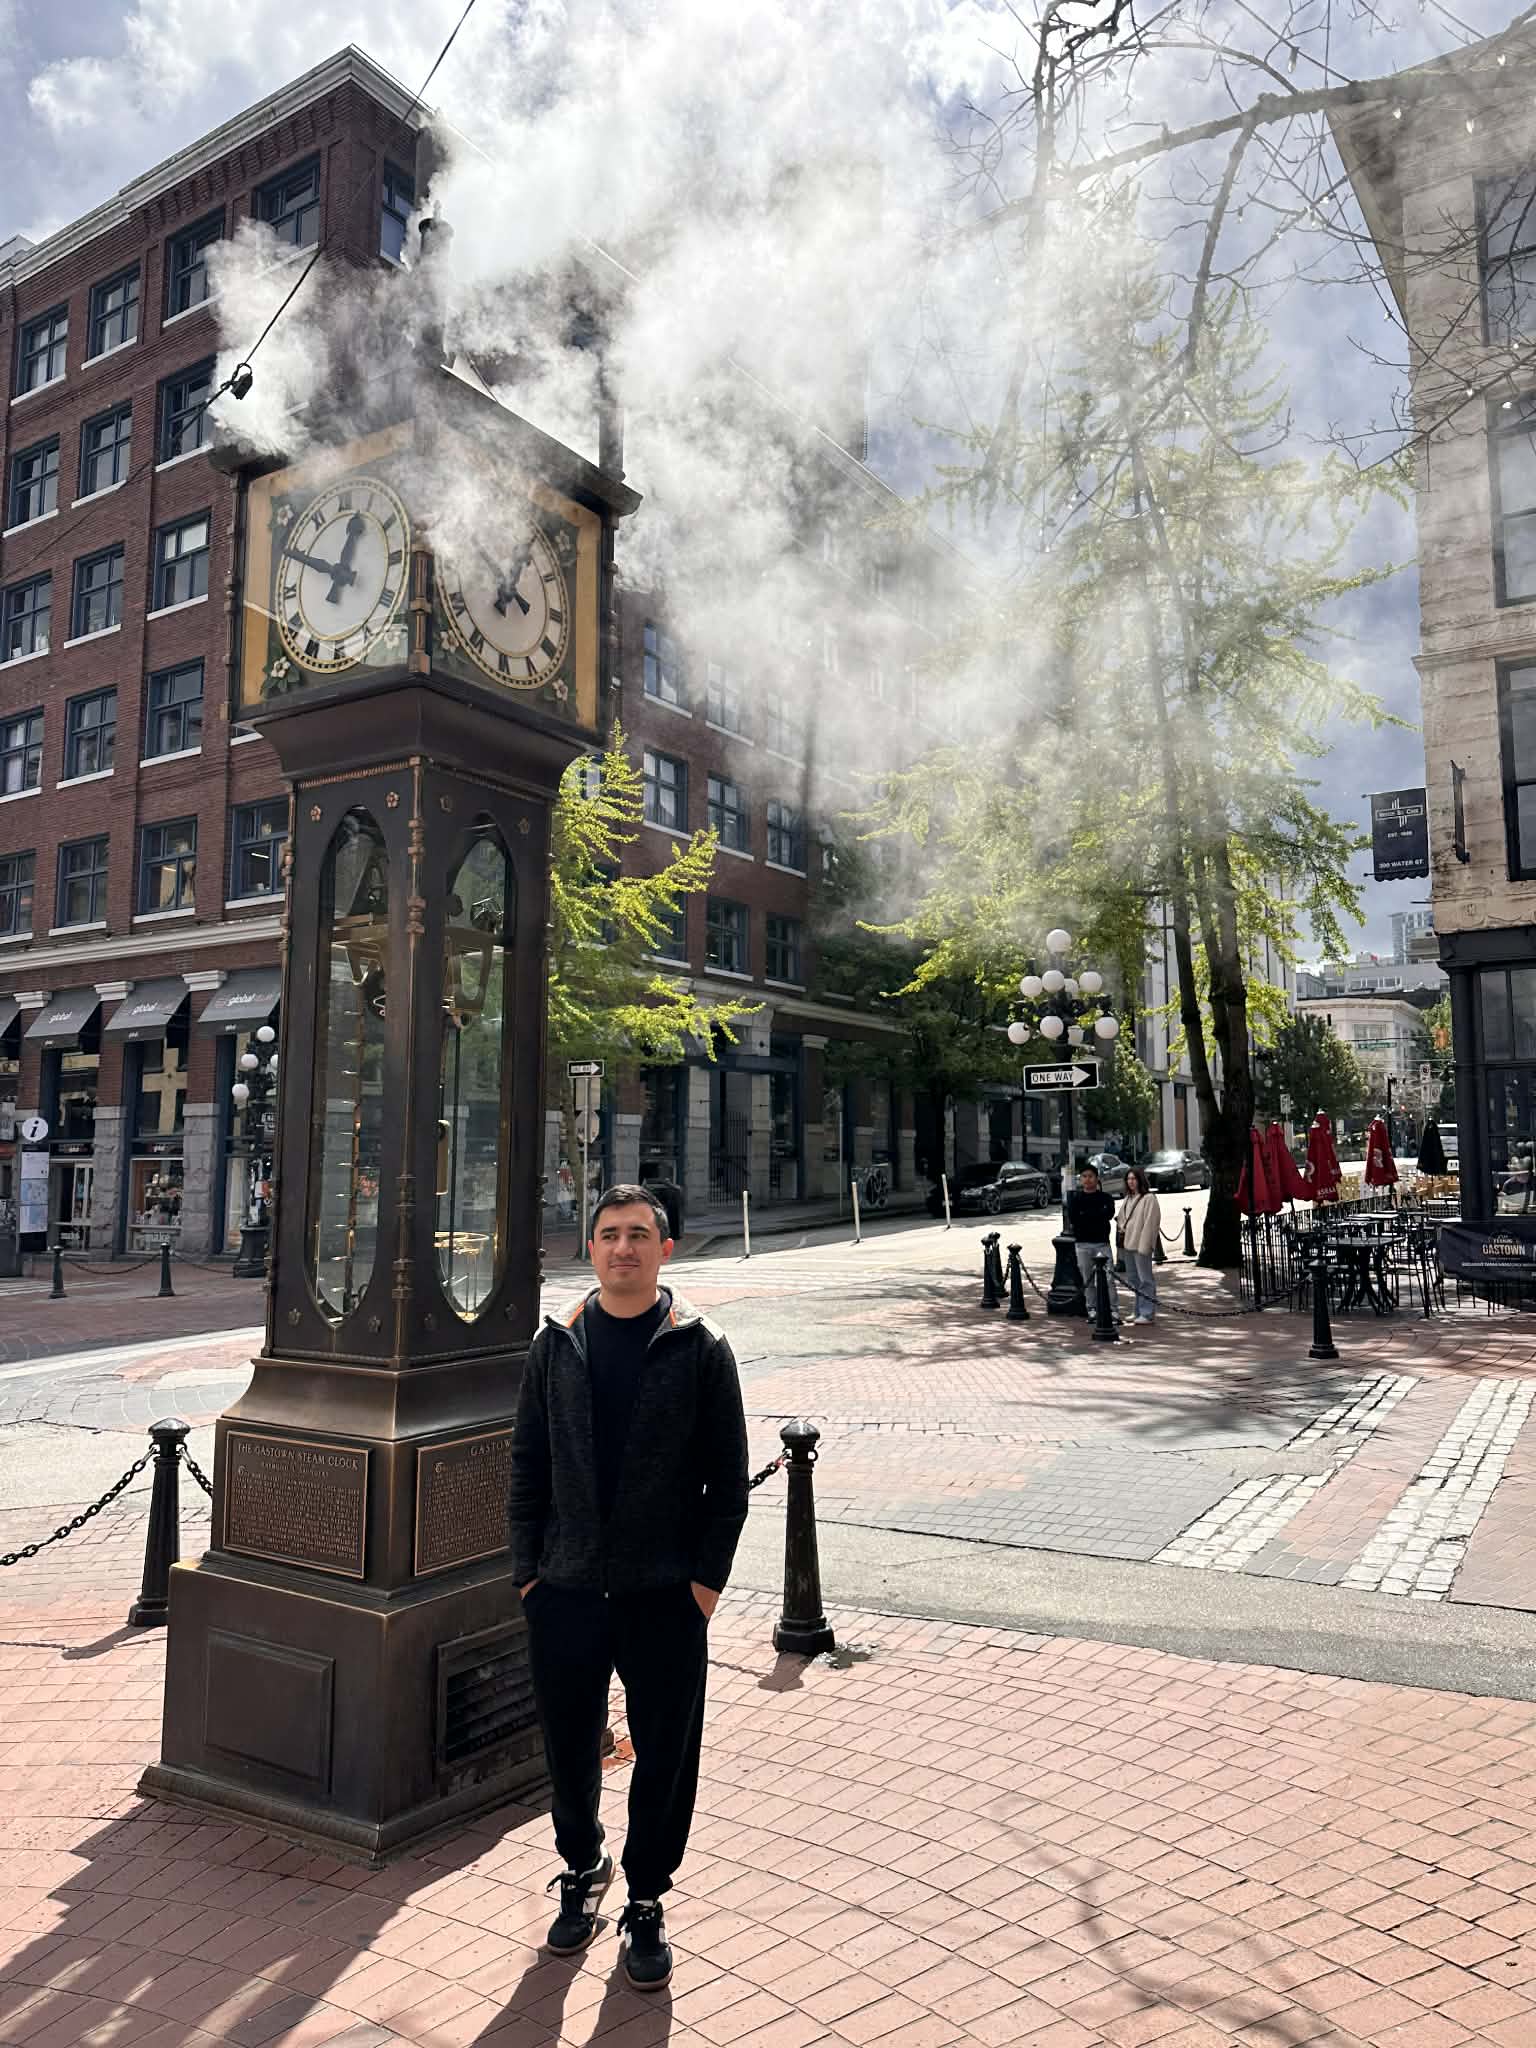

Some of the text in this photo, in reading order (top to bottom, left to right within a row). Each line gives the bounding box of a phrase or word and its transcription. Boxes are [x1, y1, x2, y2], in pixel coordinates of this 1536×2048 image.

[1392, 859, 1414, 867] WATER
[1032, 1071, 1073, 1083] ONE WAY
[1482, 1244, 1526, 1256] GASTOWN
[470, 1439, 512, 1457] GASTOW
[238, 1443, 251, 1454] THE
[255, 1446, 295, 1460] GASTOWN
[328, 1455, 359, 1471] CLOCK
